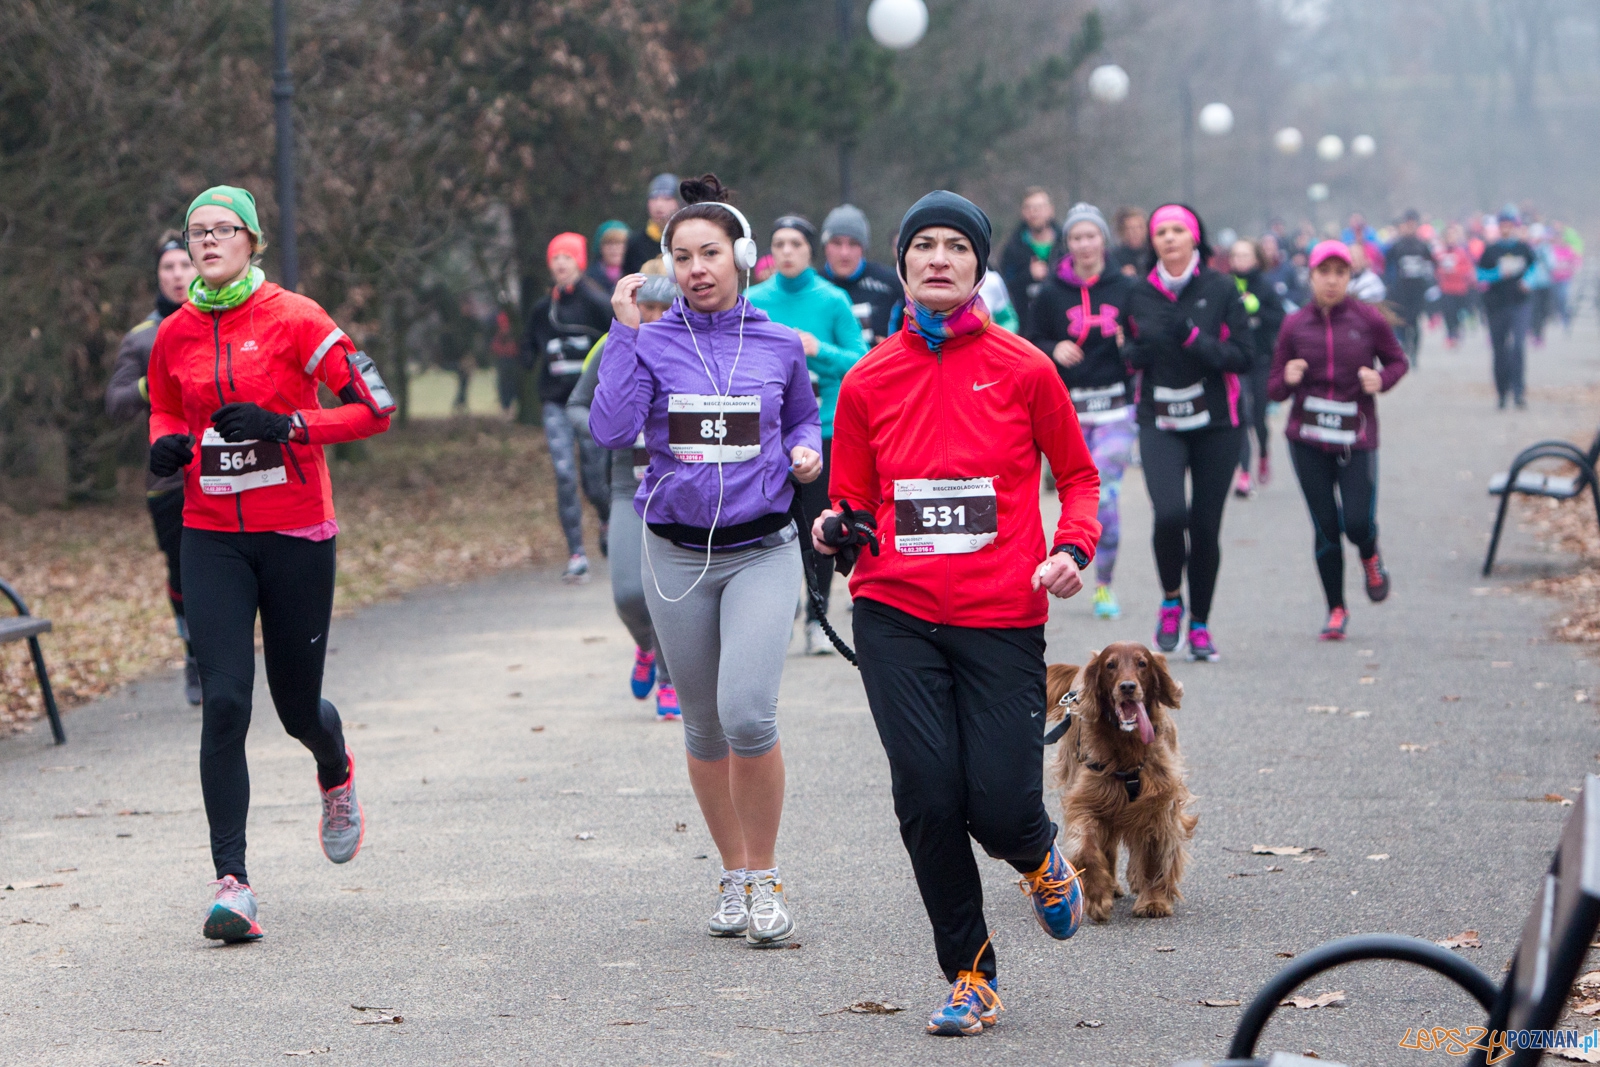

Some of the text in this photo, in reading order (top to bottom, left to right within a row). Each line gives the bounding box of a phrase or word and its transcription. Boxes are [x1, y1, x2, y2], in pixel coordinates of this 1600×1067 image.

[700, 419, 728, 439] 85
[220, 449, 257, 471] 564
[922, 505, 966, 527] 531
